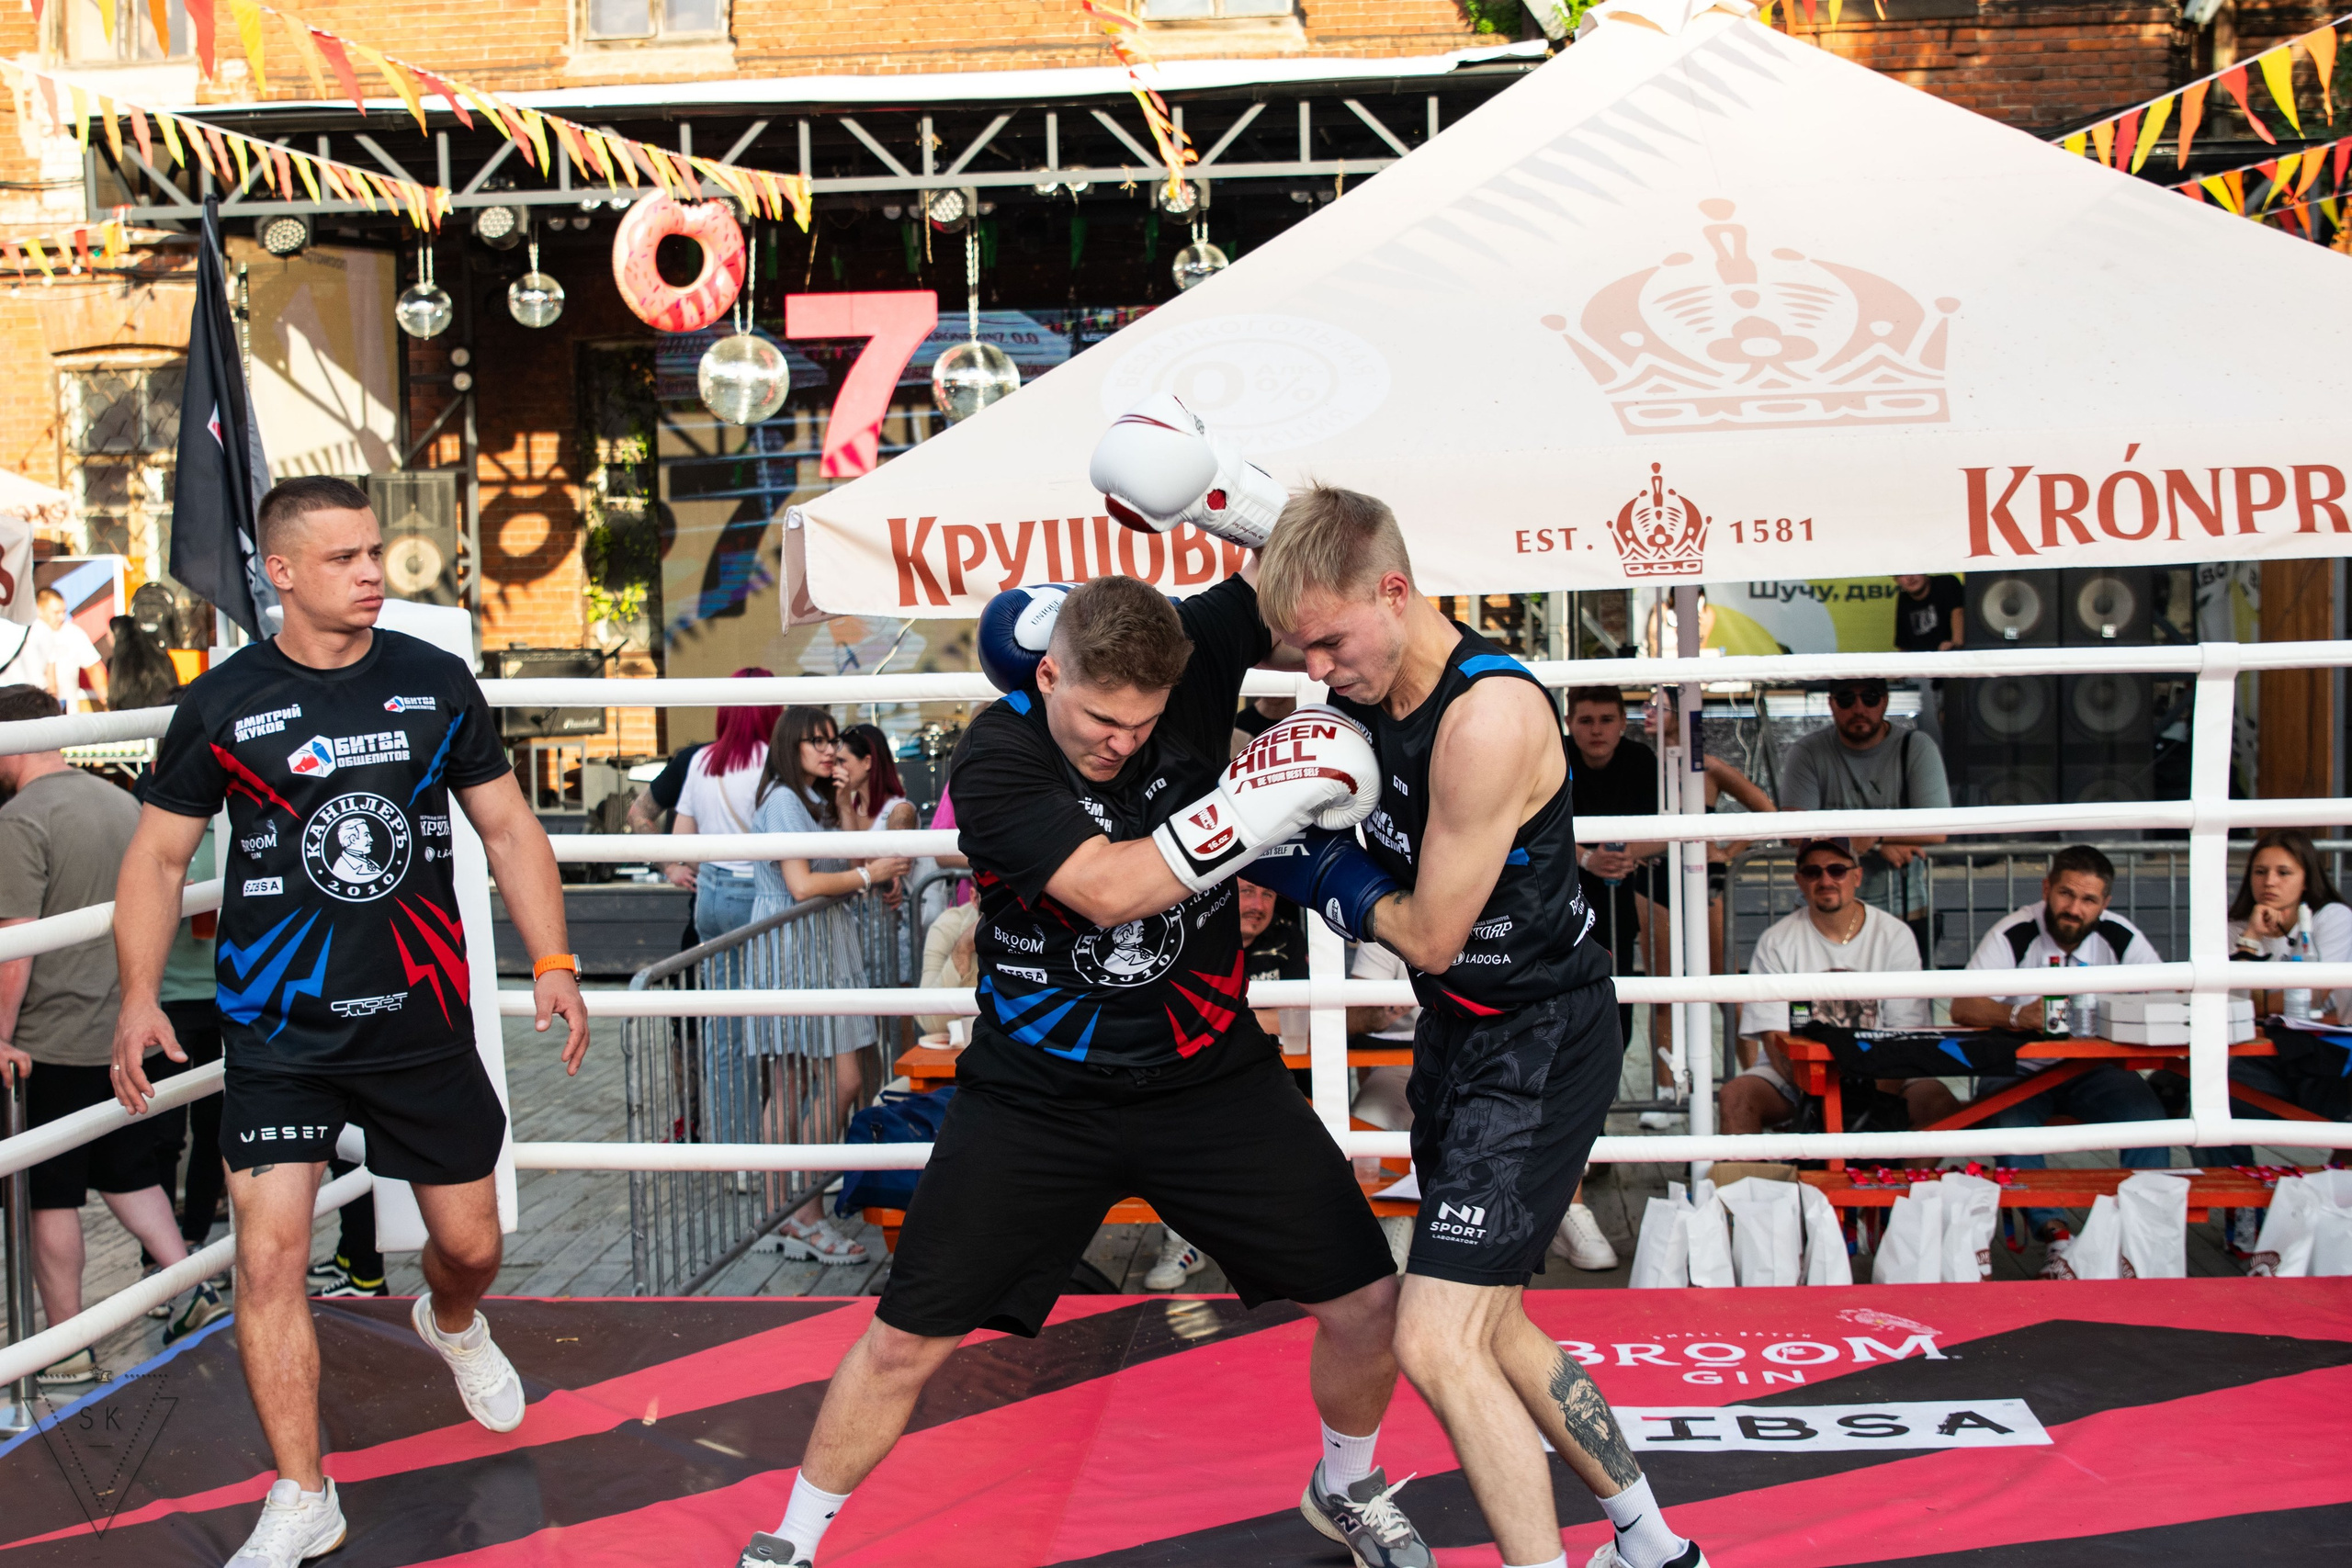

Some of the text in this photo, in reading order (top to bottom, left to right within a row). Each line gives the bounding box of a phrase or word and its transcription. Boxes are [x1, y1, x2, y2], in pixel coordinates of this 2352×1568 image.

[786, 290, 938, 478] 7
[1958, 443, 2352, 558] KRÓNPR
[1515, 517, 1815, 554] EST. 1581
[1748, 581, 1839, 603] Шучу,
[234, 704, 302, 733] ДМИТРИЙ
[234, 719, 286, 743] ЖУКОВ
[334, 730, 410, 756] БИТВА
[1232, 724, 1338, 763] GREEN
[337, 750, 411, 768] ОБЩЕПИТОВ
[1229, 740, 1317, 781] HILL
[1303, 767, 1319, 778] SELF
[1393, 774, 1408, 796] GTO
[306, 795, 409, 859] КАНЦЛЕРЪ
[241, 834, 277, 852] BROOM
[1273, 846, 1288, 856] SELF
[327, 873, 395, 897] 2010
[994, 926, 1045, 954] BROOM
[1465, 953, 1511, 964] LADOGA
[240, 1125, 329, 1143] VESET
[1430, 1221, 1487, 1239] SPORT
[1431, 1234, 1479, 1246] LABORATORY
[1555, 1335, 1949, 1367] BROOM
[1682, 1370, 1805, 1385] GIN
